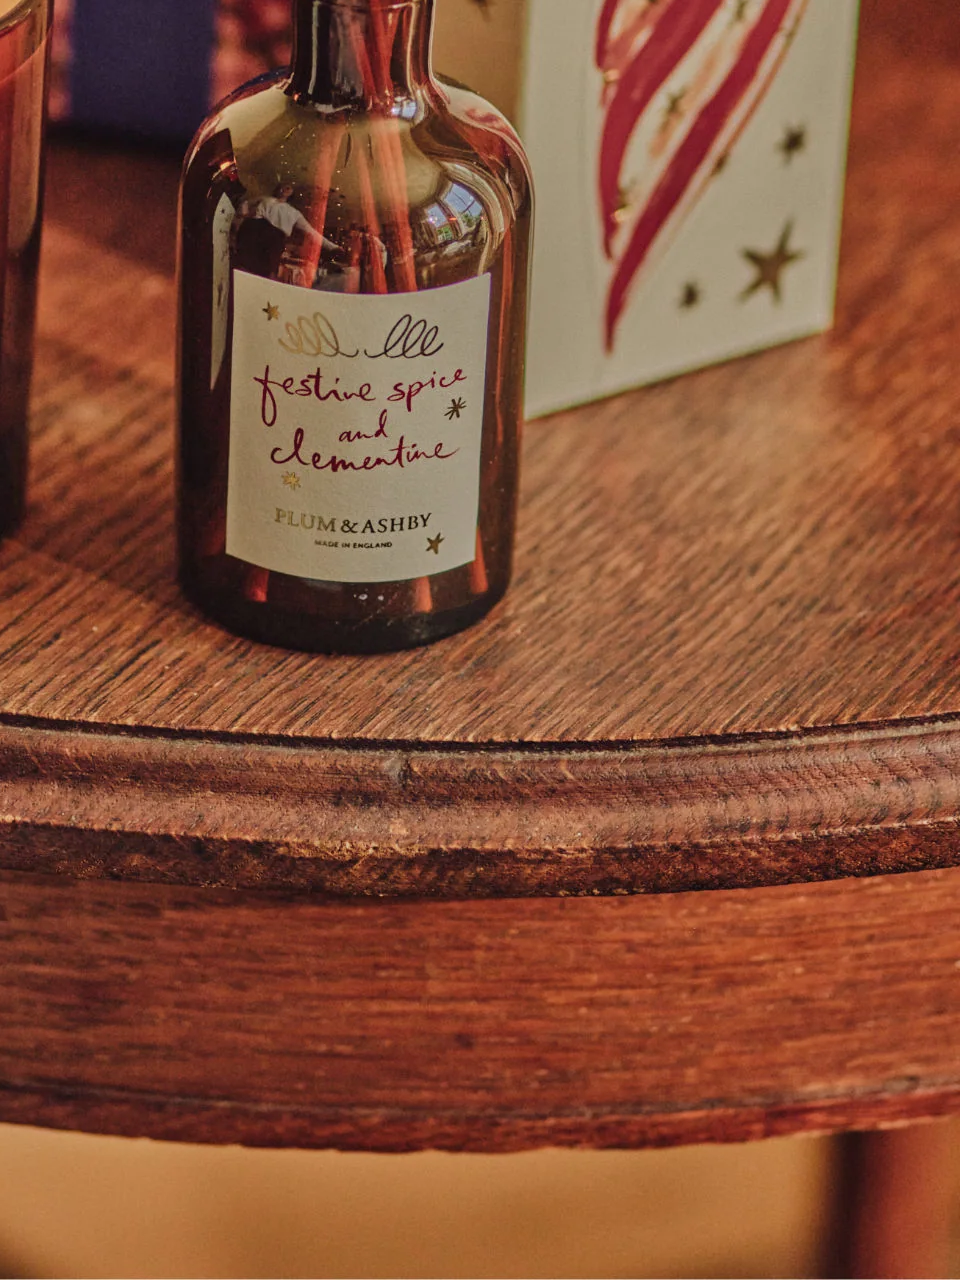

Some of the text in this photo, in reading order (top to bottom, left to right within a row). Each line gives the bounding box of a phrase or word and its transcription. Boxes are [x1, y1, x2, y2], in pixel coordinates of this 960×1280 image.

[253, 365, 467, 427] festive spice
[338, 409, 388, 443] and
[270, 427, 460, 472] clementine
[314, 539, 339, 548] MADE
[353, 540, 393, 549] ENGLAND
